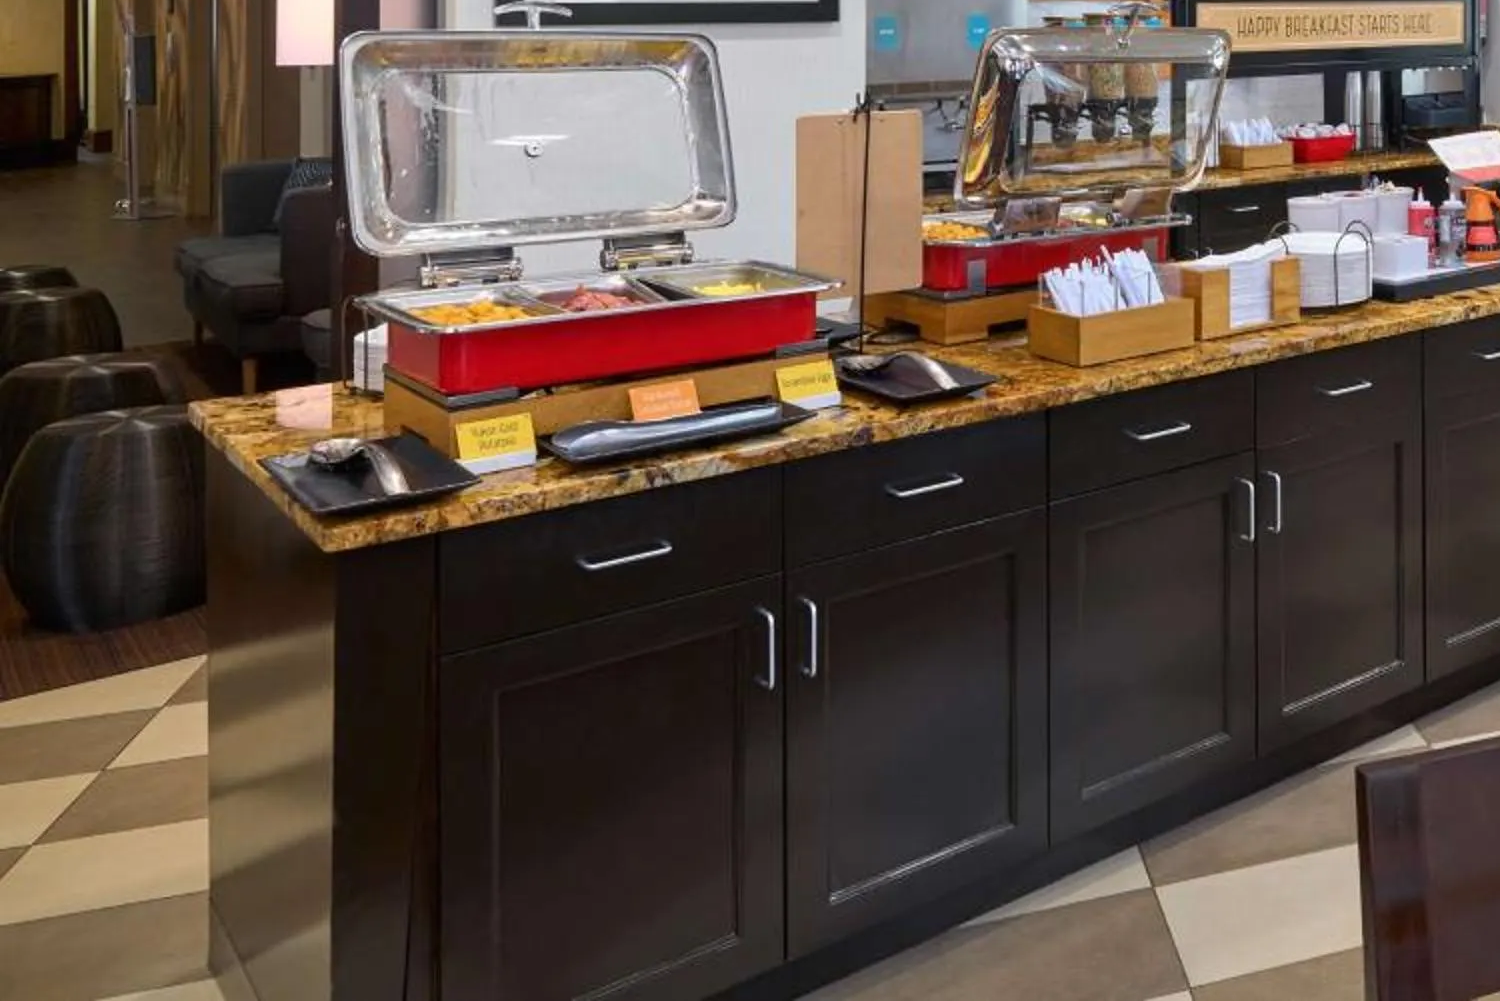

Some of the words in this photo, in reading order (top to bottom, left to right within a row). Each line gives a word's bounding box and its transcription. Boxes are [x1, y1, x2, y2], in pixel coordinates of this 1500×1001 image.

[1237, 15, 1281, 39] HAPPY
[1285, 12, 1354, 38] BREAKFAST
[1359, 12, 1400, 35] STARTS
